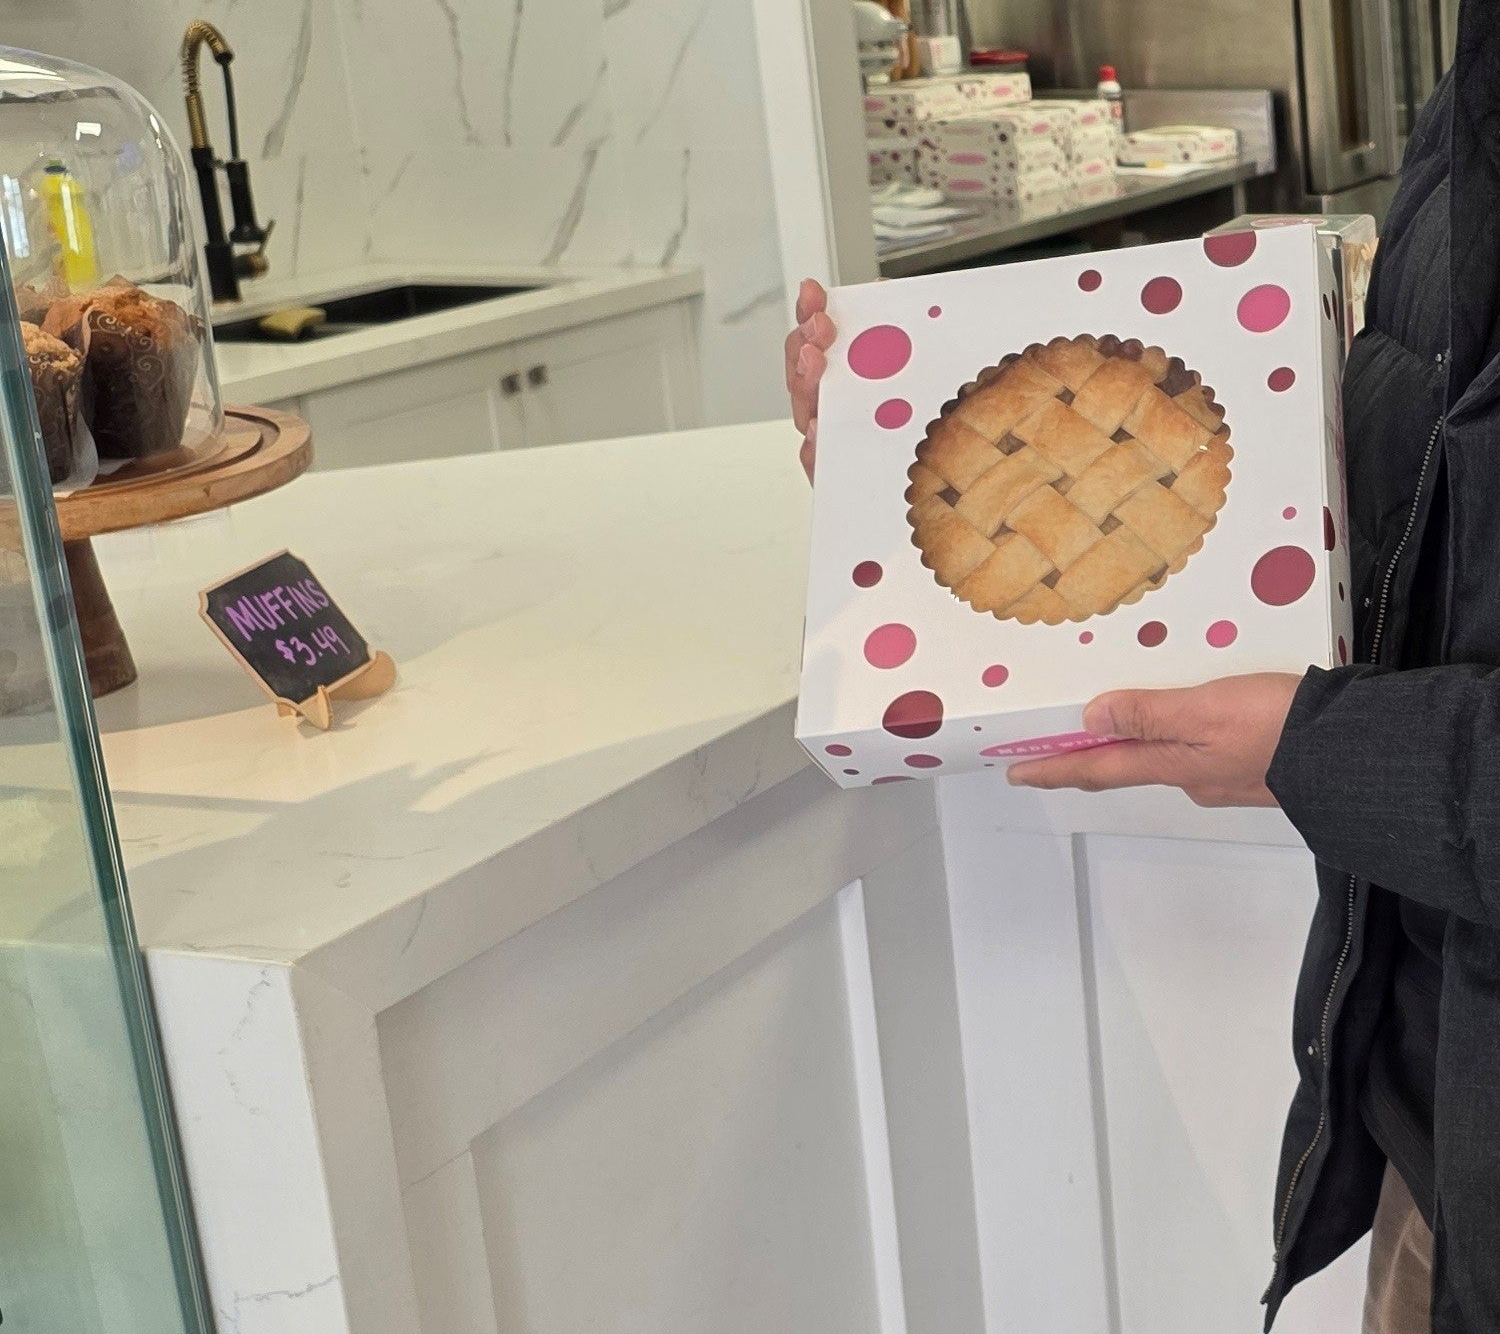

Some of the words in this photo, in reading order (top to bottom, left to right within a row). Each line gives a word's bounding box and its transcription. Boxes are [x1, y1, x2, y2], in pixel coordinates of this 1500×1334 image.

[225, 579, 329, 642] MUFFINS
[275, 625, 351, 666] $3.49
[997, 744, 1051, 755] MADE
